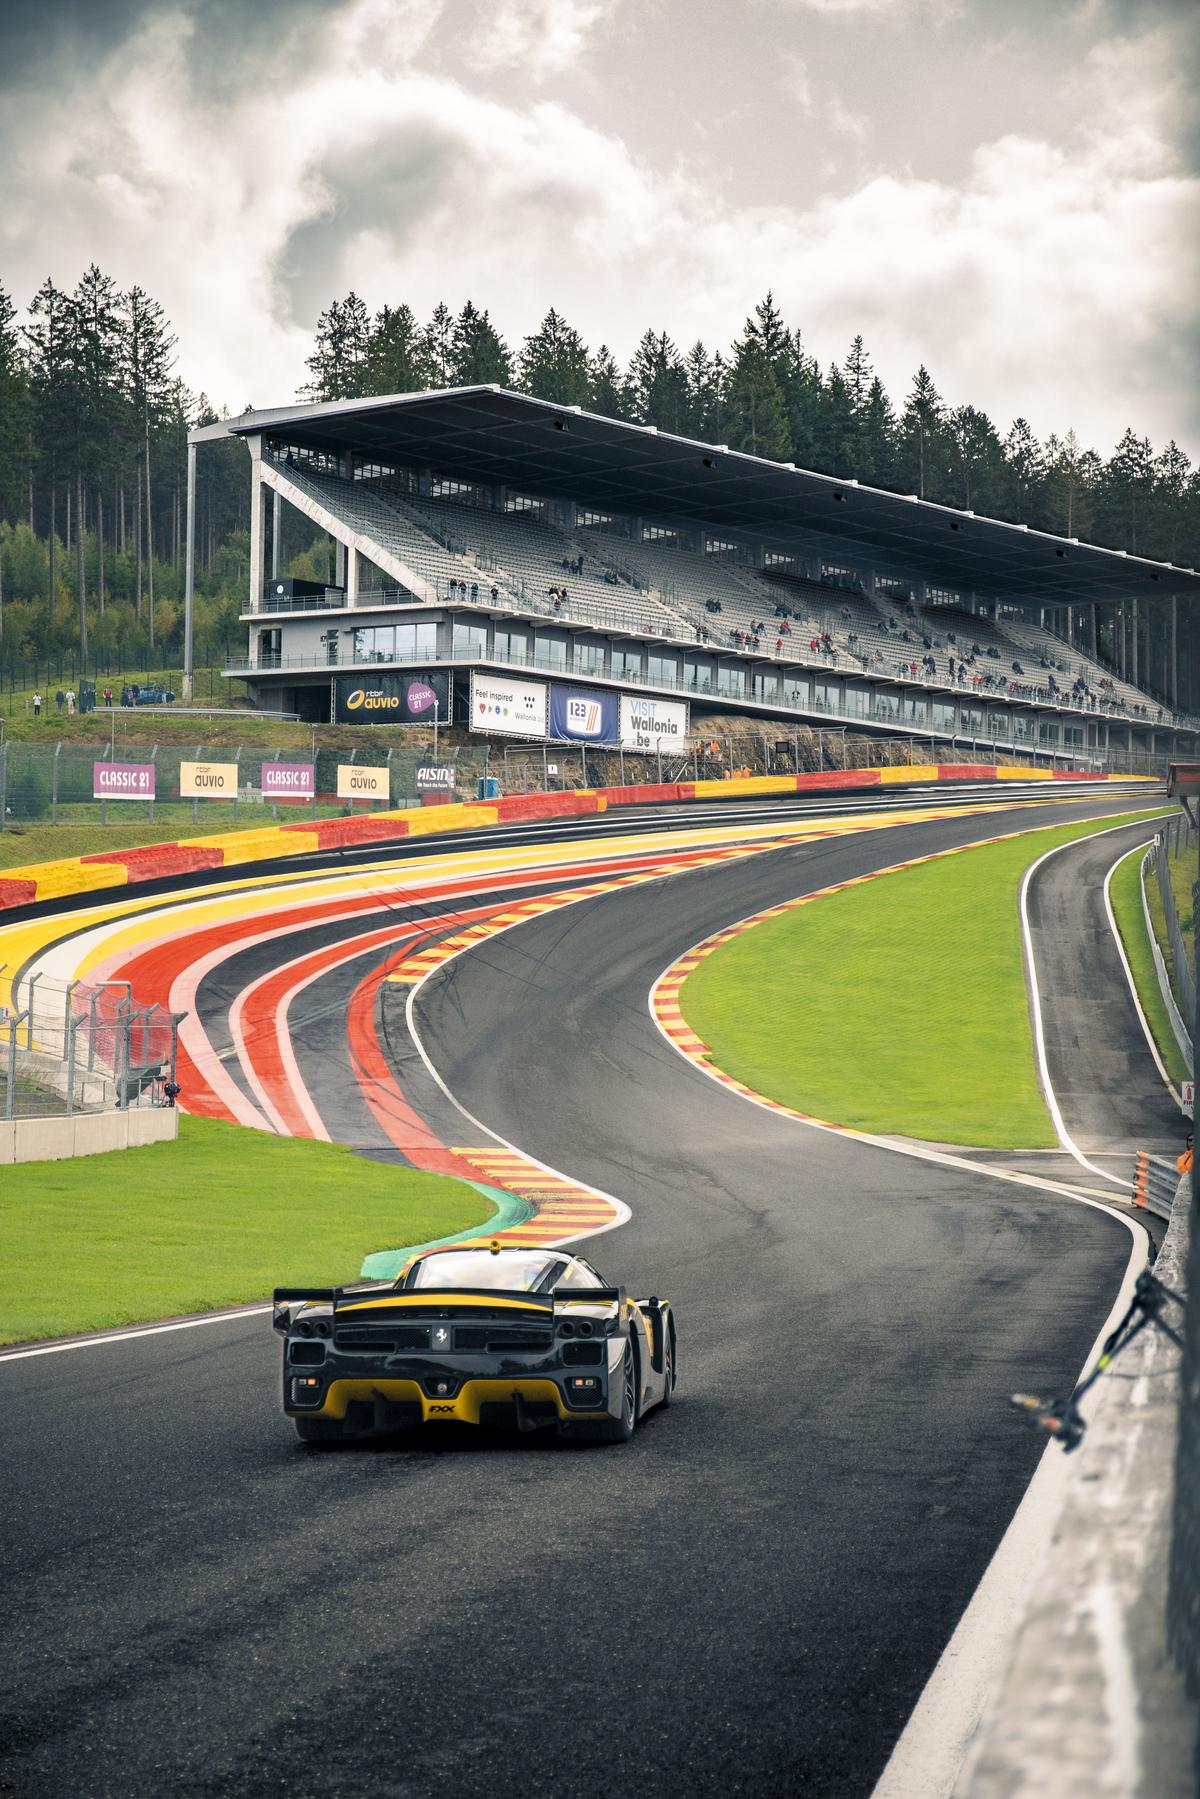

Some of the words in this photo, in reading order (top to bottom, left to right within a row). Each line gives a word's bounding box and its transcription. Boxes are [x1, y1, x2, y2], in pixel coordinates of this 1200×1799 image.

[409, 691, 431, 702] CLASSIC
[475, 689, 488, 698] Feel
[489, 691, 513, 702] inspired
[413, 700, 422, 709] 21
[570, 702, 587, 717] 123
[630, 701, 657, 716] VISIT
[631, 716, 678, 734] Wallonia
[100, 771, 136, 787] CLASSIC
[139, 772, 150, 787] 21
[266, 771, 299, 785] CLASSIC
[300, 771, 310, 785] 21
[417, 768, 449, 780] AISIN
